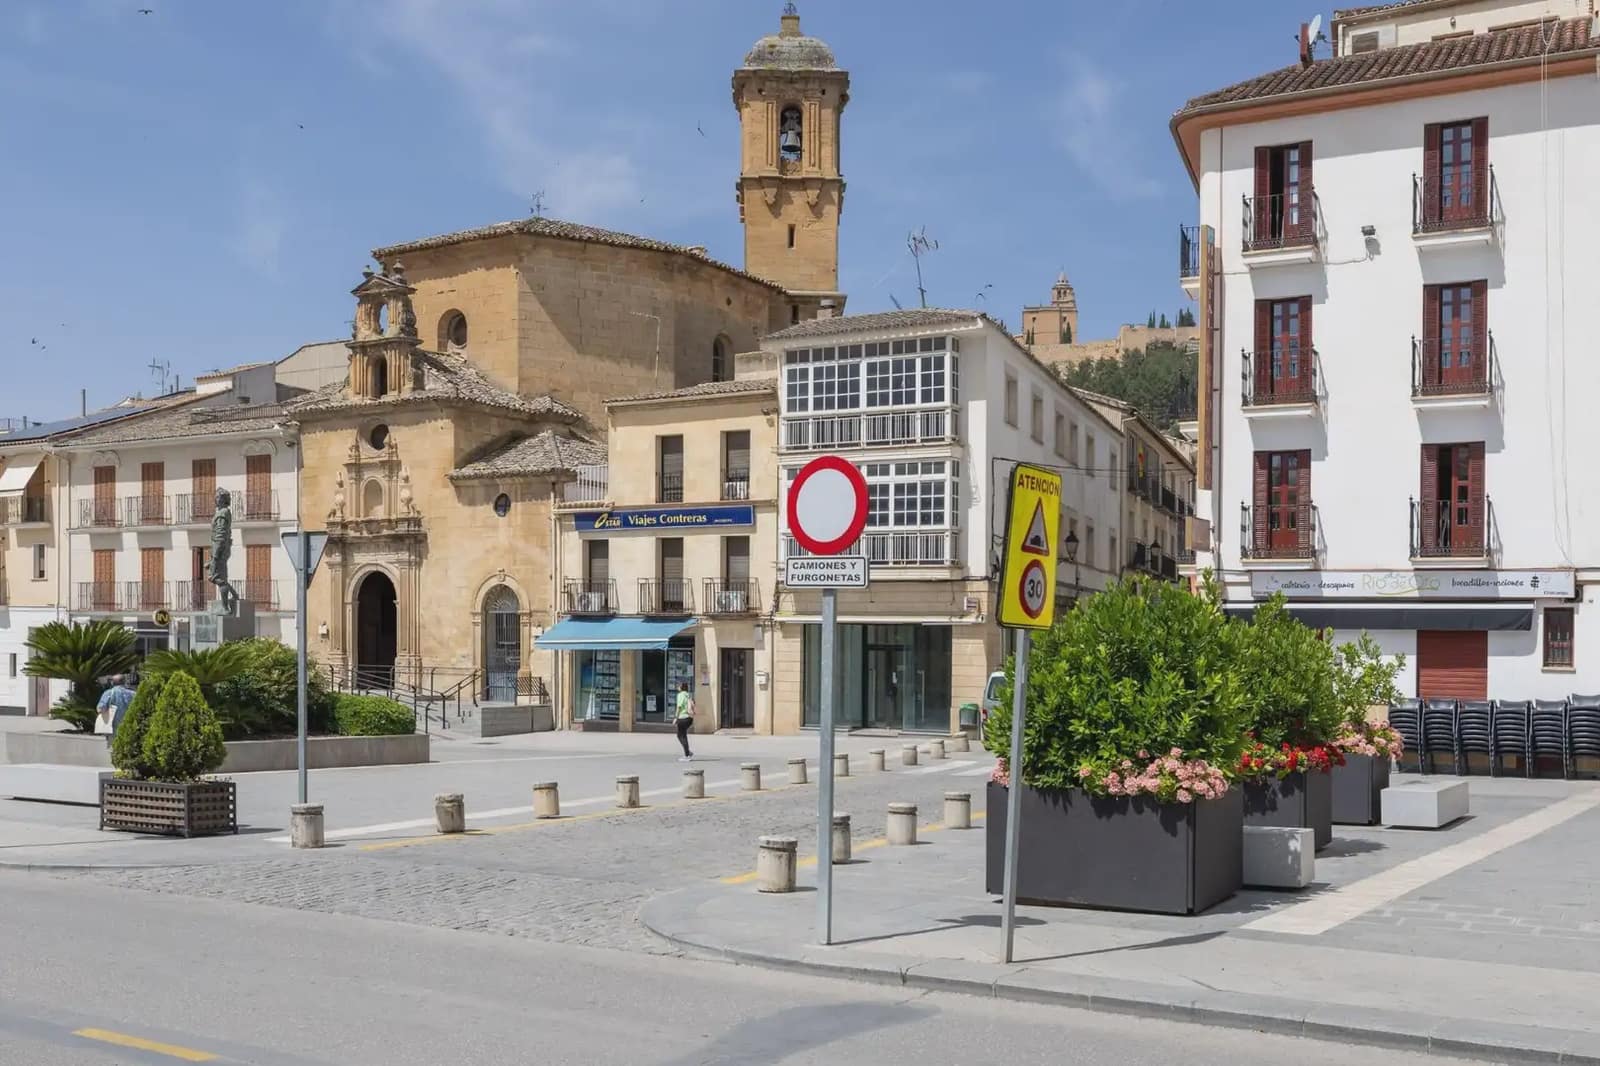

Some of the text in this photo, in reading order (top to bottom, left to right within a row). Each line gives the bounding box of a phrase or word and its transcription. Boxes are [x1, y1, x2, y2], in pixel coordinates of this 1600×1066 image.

[628, 514, 657, 526] Viajes
[660, 513, 707, 524] Contreras
[792, 561, 857, 570] CAMIONES Y
[791, 573, 861, 582] FURGONETAS
[1027, 579, 1043, 598] 30
